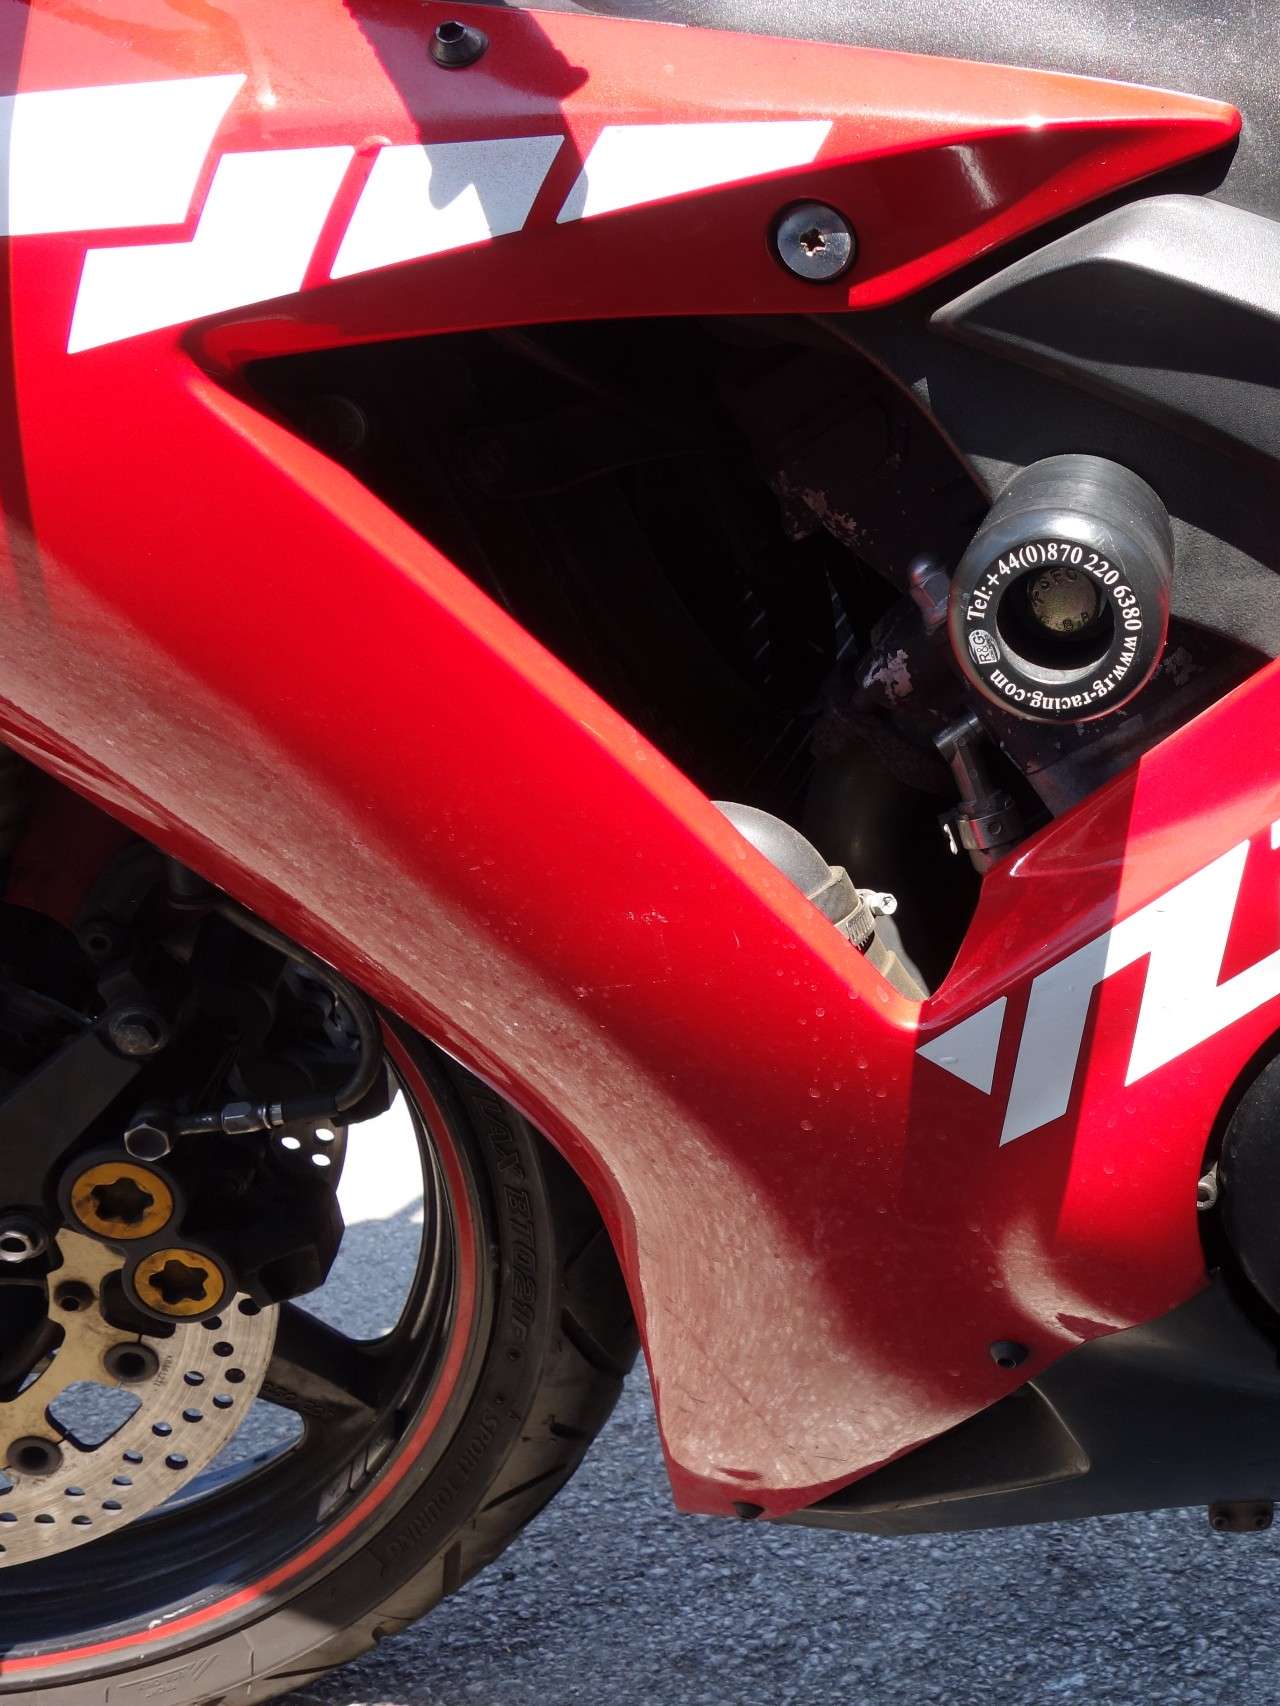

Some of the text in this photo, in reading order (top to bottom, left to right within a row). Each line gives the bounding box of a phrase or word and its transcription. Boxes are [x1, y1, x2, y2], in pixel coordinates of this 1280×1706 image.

[1083, 553, 1120, 585] 220
[1113, 585, 1142, 632] 6380
[989, 635, 1138, 710] www.rg-racing.com
[389, 1411, 500, 1561] SPORT TOURING
